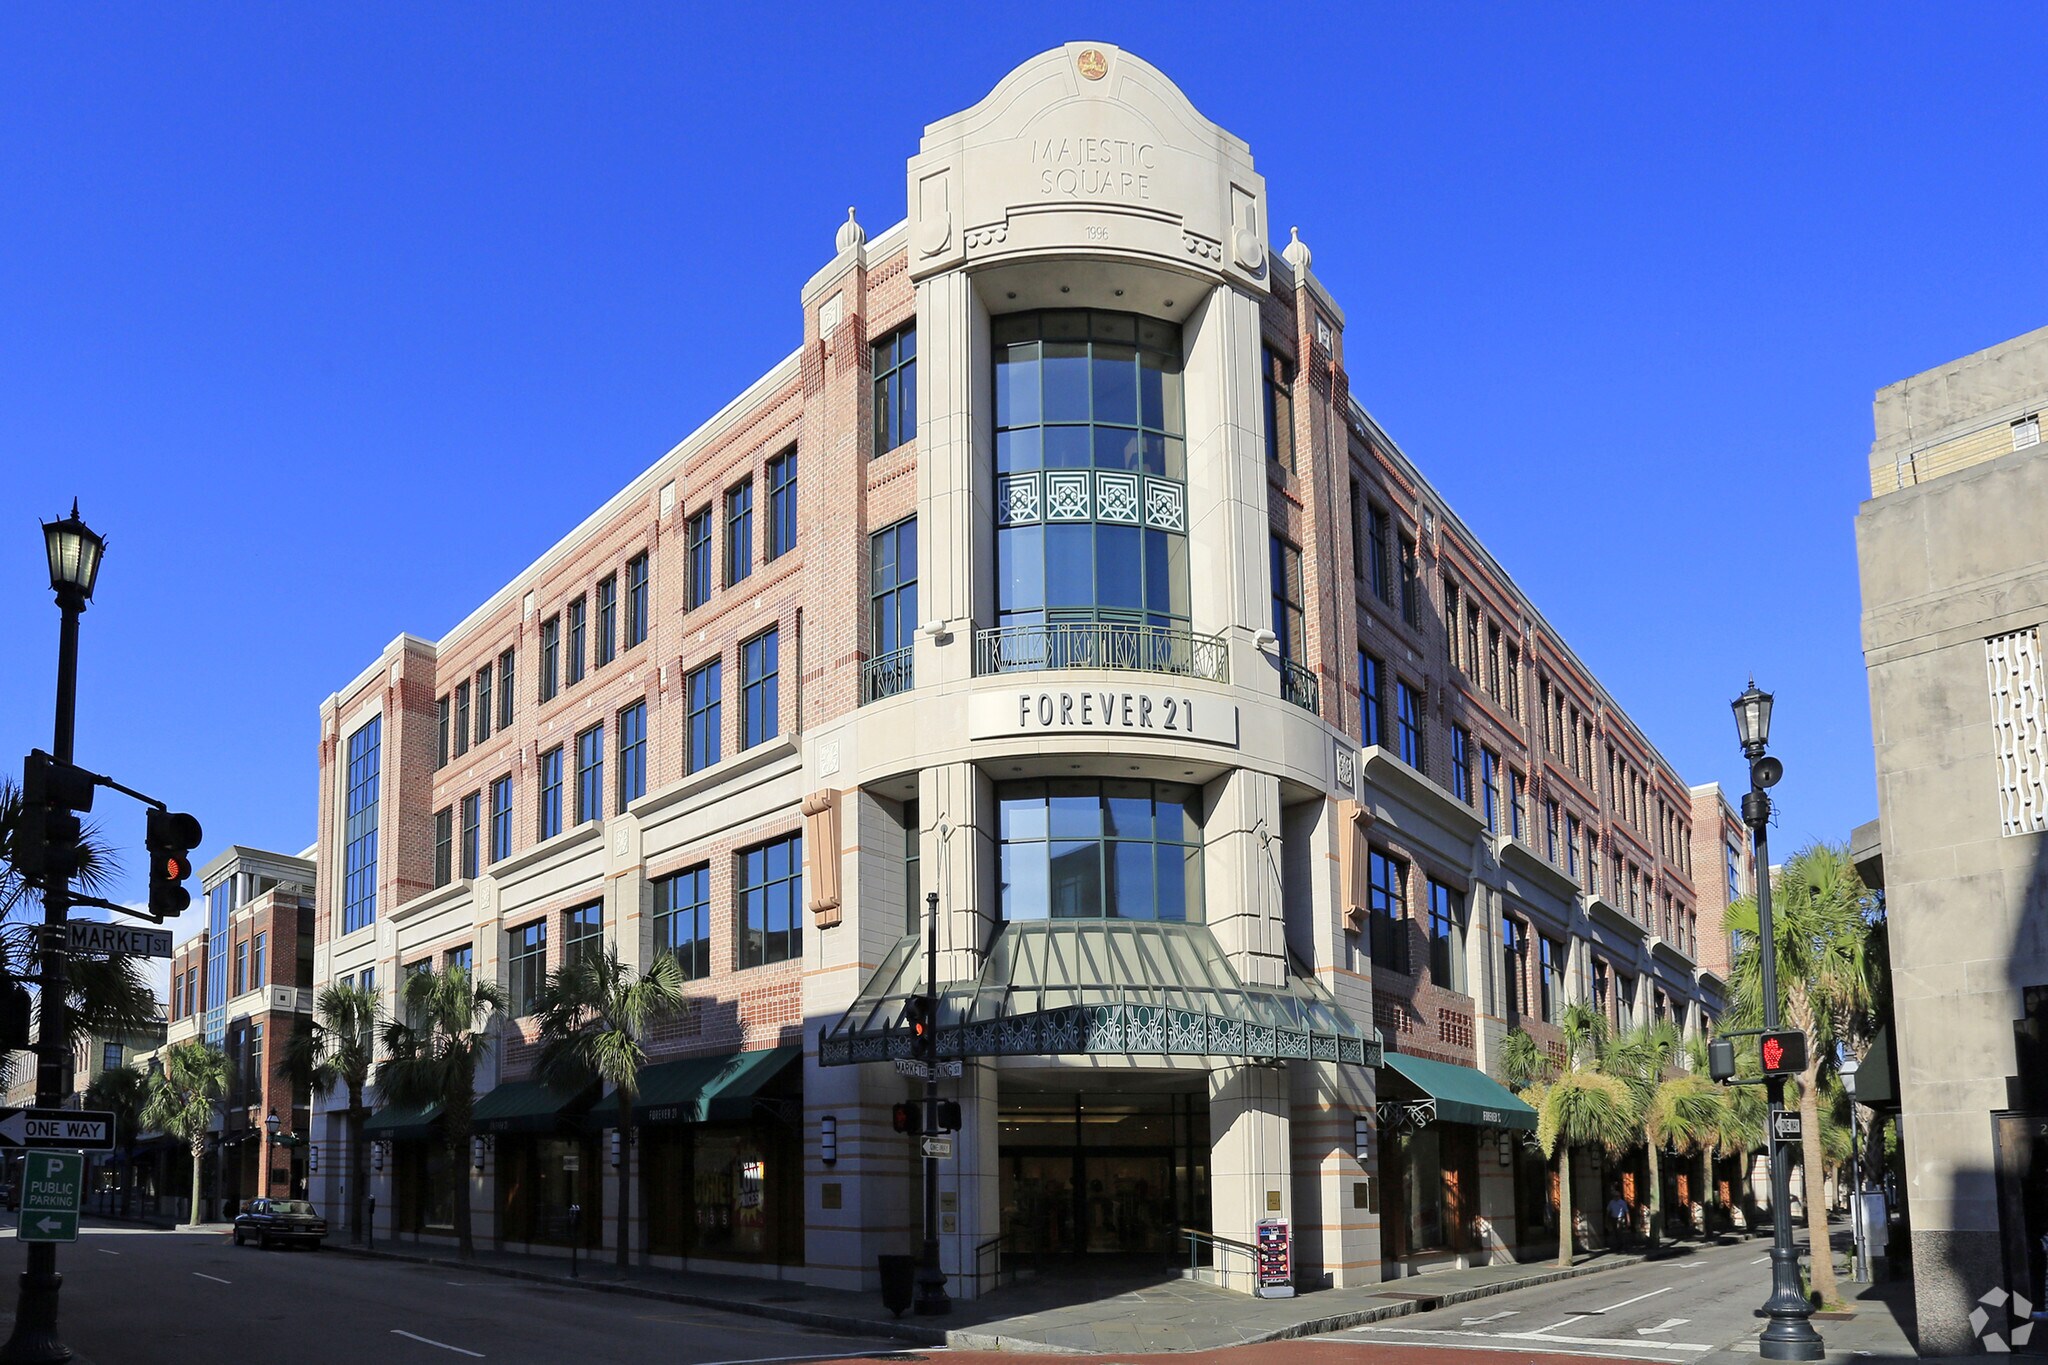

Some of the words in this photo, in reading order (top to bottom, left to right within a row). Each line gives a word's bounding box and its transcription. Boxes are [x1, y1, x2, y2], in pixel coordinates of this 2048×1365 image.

[1031, 138, 1156, 169] MAJESTIC
[1040, 168, 1150, 199] SQUARE
[1085, 226, 1109, 241] 1996
[1019, 692, 1153, 728] FOREVER
[1163, 696, 1193, 732] 21
[71, 926, 154, 953] MARKET
[154, 938, 169, 952] ST
[895, 1062, 921, 1076] MARKET
[937, 1065, 952, 1077] KING
[649, 1108, 671, 1120] FOREVER
[25, 1121, 60, 1136] ONE
[67, 1122, 102, 1138] WAY
[1781, 1120, 1790, 1131] ONE
[1790, 1120, 1799, 1130] WAY
[46, 1158, 64, 1178] P
[31, 1181, 73, 1195] PUBLIC
[29, 1195, 73, 1207] PARKING
